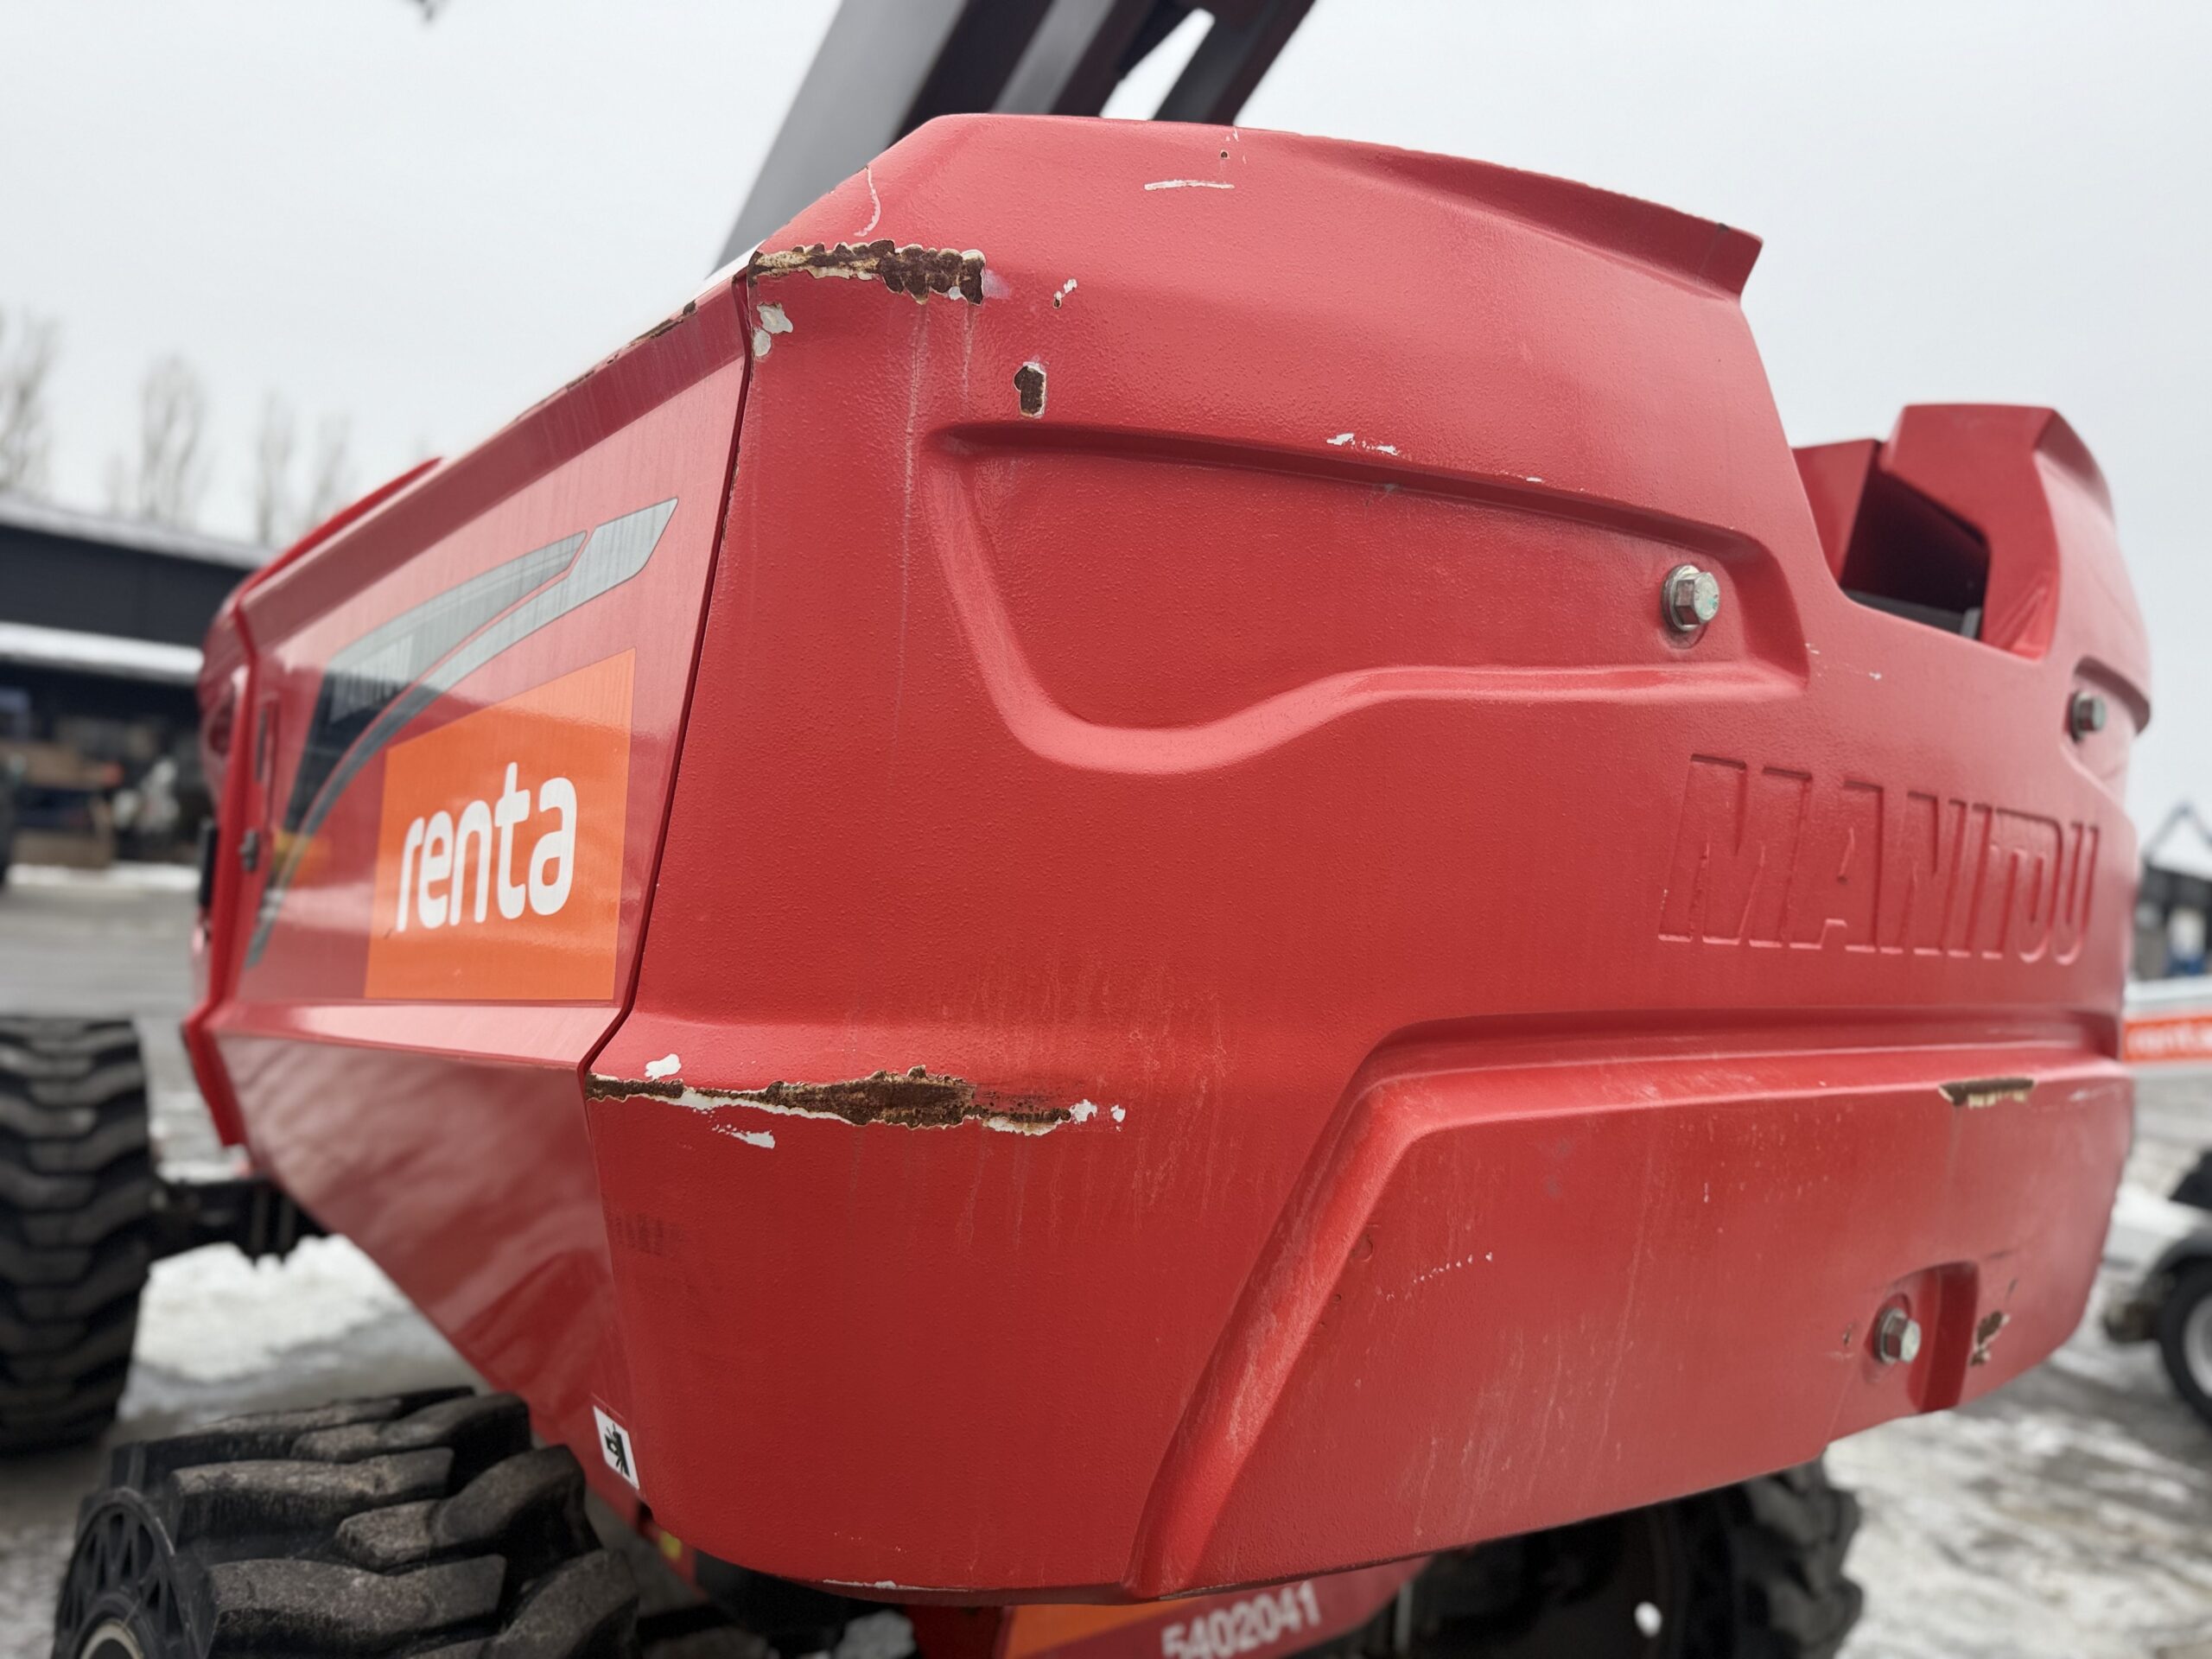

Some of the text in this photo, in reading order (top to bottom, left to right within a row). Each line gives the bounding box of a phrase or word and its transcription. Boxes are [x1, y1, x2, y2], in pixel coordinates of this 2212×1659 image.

[396, 761, 577, 932] renta
[1658, 753, 2100, 965] MANITOU
[1161, 1580, 1320, 1659] 5402041
